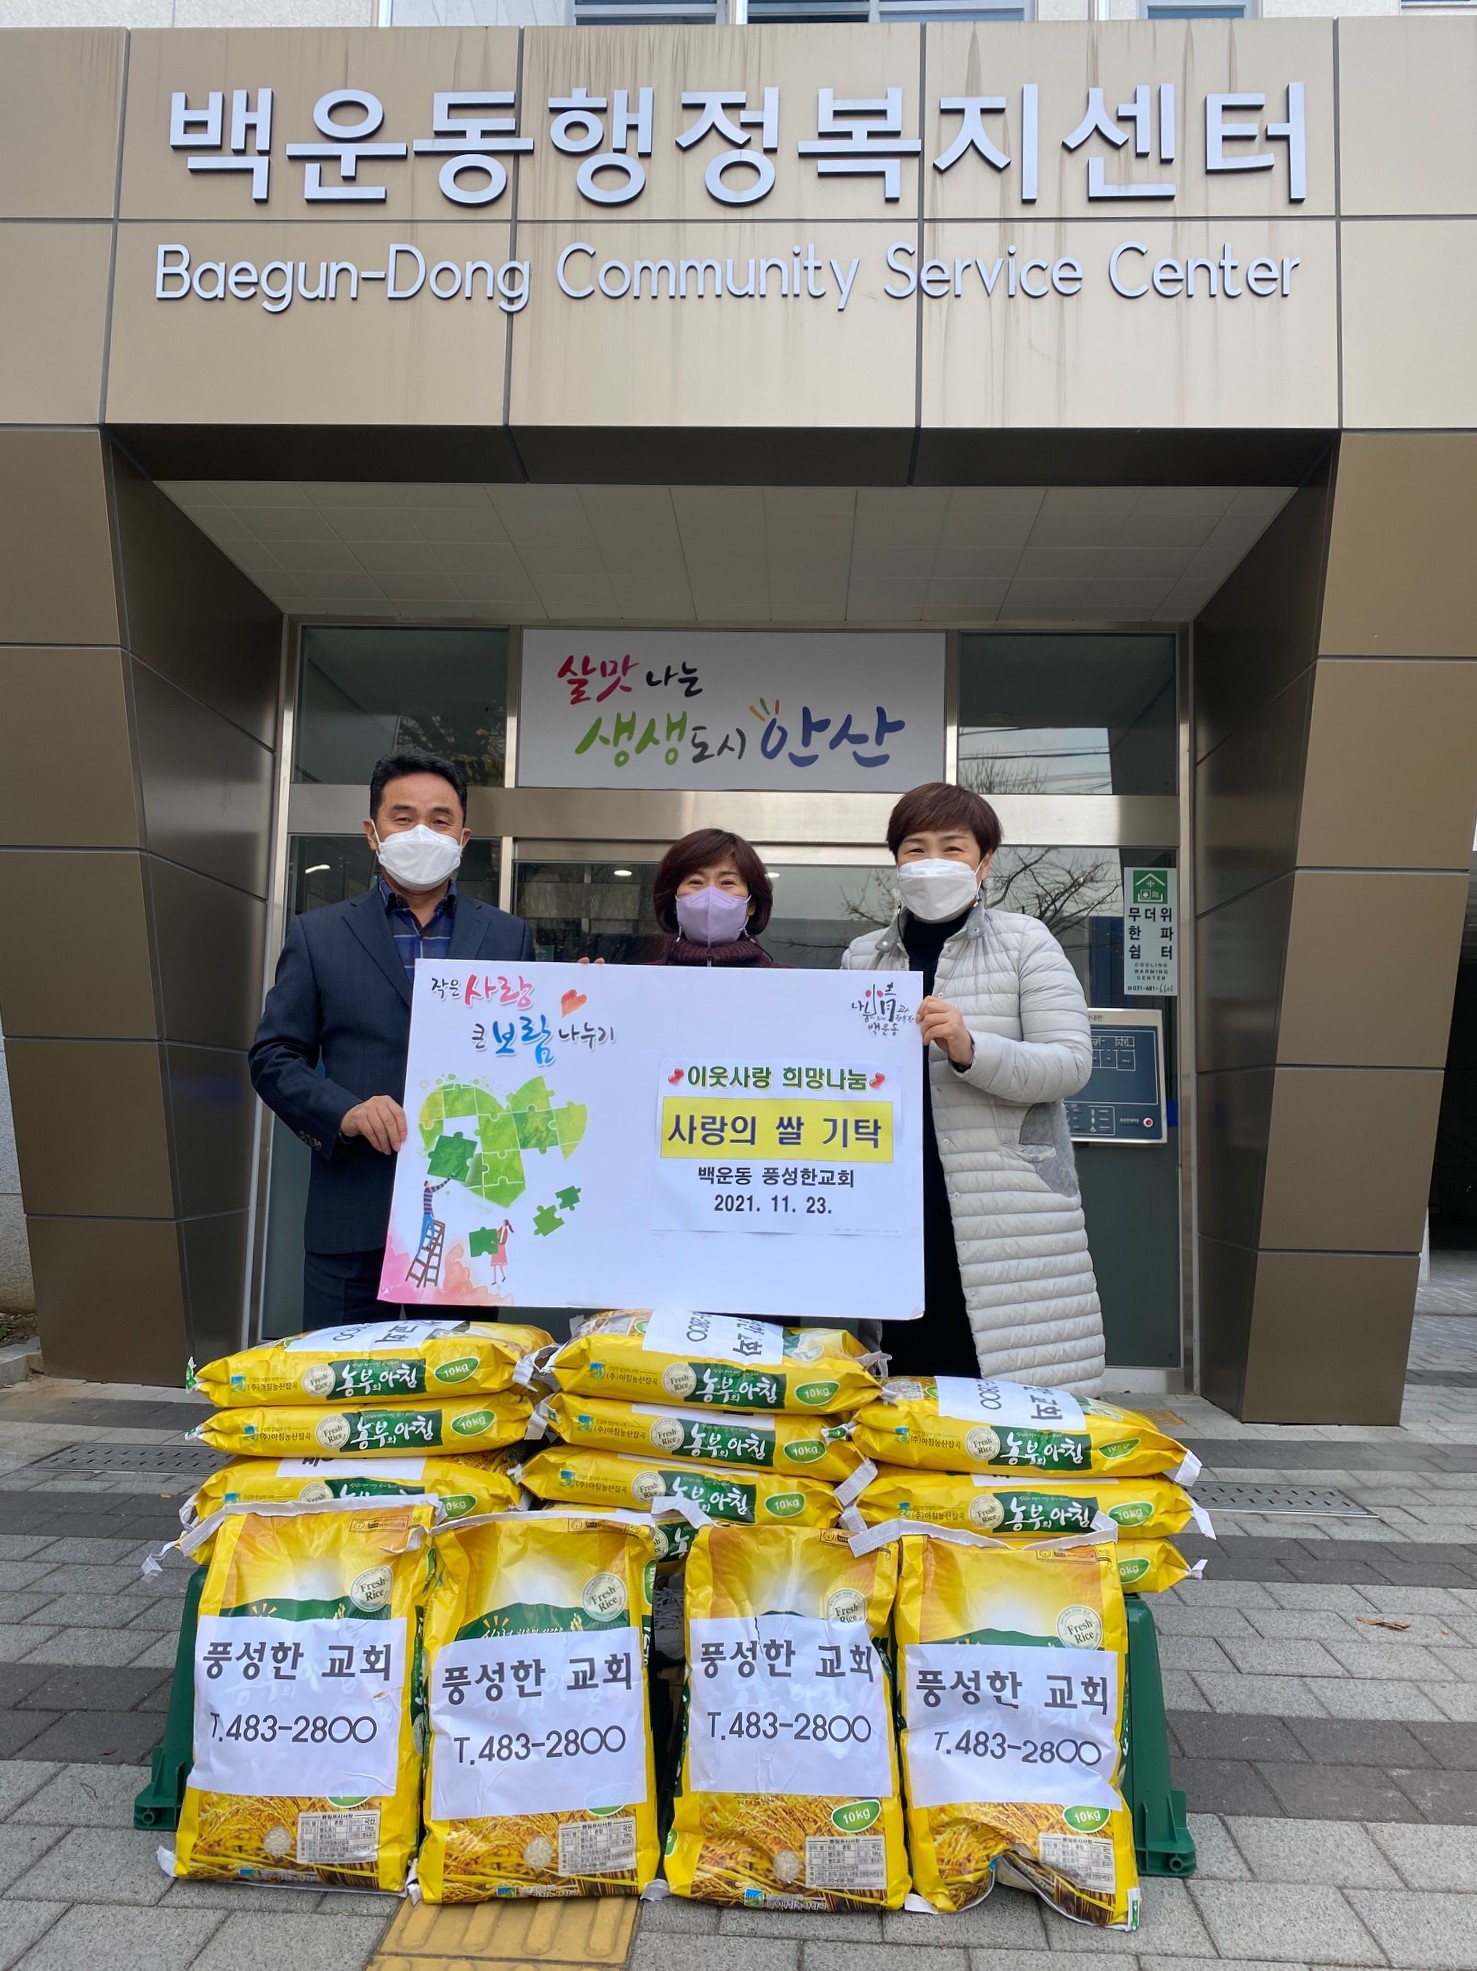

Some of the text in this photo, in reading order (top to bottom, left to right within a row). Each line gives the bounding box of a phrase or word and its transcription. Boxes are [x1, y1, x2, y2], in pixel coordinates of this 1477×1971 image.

[168, 82, 1306, 204] 백운동행정복지센터
[155, 240, 1301, 314] Baegun-Dong Community Service Center
[557, 654, 703, 705] 살맛 나는
[760, 705, 906, 768] 안산
[1128, 907, 1172, 922] 무더위
[431, 974, 535, 1010] 작은 사랑
[471, 1014, 615, 1066] 큰 보람 나누기
[687, 1065, 868, 1091] 이웃사랑 희망나눔
[667, 1114, 882, 1149] 사랑의 쌀 기탁
[698, 1166, 855, 1188] 백운동 풍성한교회
[714, 1194, 832, 1214] 2021. 11. 23.
[443, 1361, 470, 1376] 10kg
[310, 1374, 328, 1386] Fresh
[314, 1382, 328, 1392] Rice
[670, 1375, 689, 1384] Fresh
[674, 1382, 689, 1391] Rice
[804, 1387, 830, 1399] 10kg
[460, 1416, 486, 1430] 10kg
[323, 1424, 343, 1438] Fresh
[327, 1433, 342, 1443] Rice
[657, 1429, 677, 1439] Fresh
[661, 1436, 676, 1446] Rice
[973, 1437, 993, 1448] Fresh
[792, 1445, 818, 1456] 10kg
[978, 1445, 993, 1454] Rice
[640, 1482, 659, 1493] Fresh
[446, 1500, 467, 1511] 0kg
[774, 1499, 800, 1510] 10kg
[977, 1506, 996, 1518] Fresh
[982, 1514, 997, 1524] Rice
[1118, 1508, 1143, 1520] 10kg
[1120, 1562, 1140, 1577] 0kg
[360, 1578, 387, 1593] Fresh
[364, 1588, 385, 1602] Rice
[591, 1585, 616, 1605] Fresh
[598, 1594, 619, 1615] Rice
[835, 1603, 859, 1618] Fresh
[1067, 1621, 1094, 1636] Fresh
[1073, 1630, 1095, 1645] Rice
[202, 1641, 392, 1681] 풍성한 교회
[700, 1639, 874, 1682] 풍성한 교회
[442, 1652, 633, 1706] 풍성한 교회
[916, 1669, 1108, 1715] 풍성한 교회
[211, 1711, 377, 1744] T.483-2800
[707, 1711, 872, 1743] T.483-2800
[454, 1725, 626, 1766] T.483-2800
[934, 1730, 1101, 1767] T.483-2800
[842, 1808, 870, 1825] 10kg
[1074, 1810, 1101, 1824] 10kg
